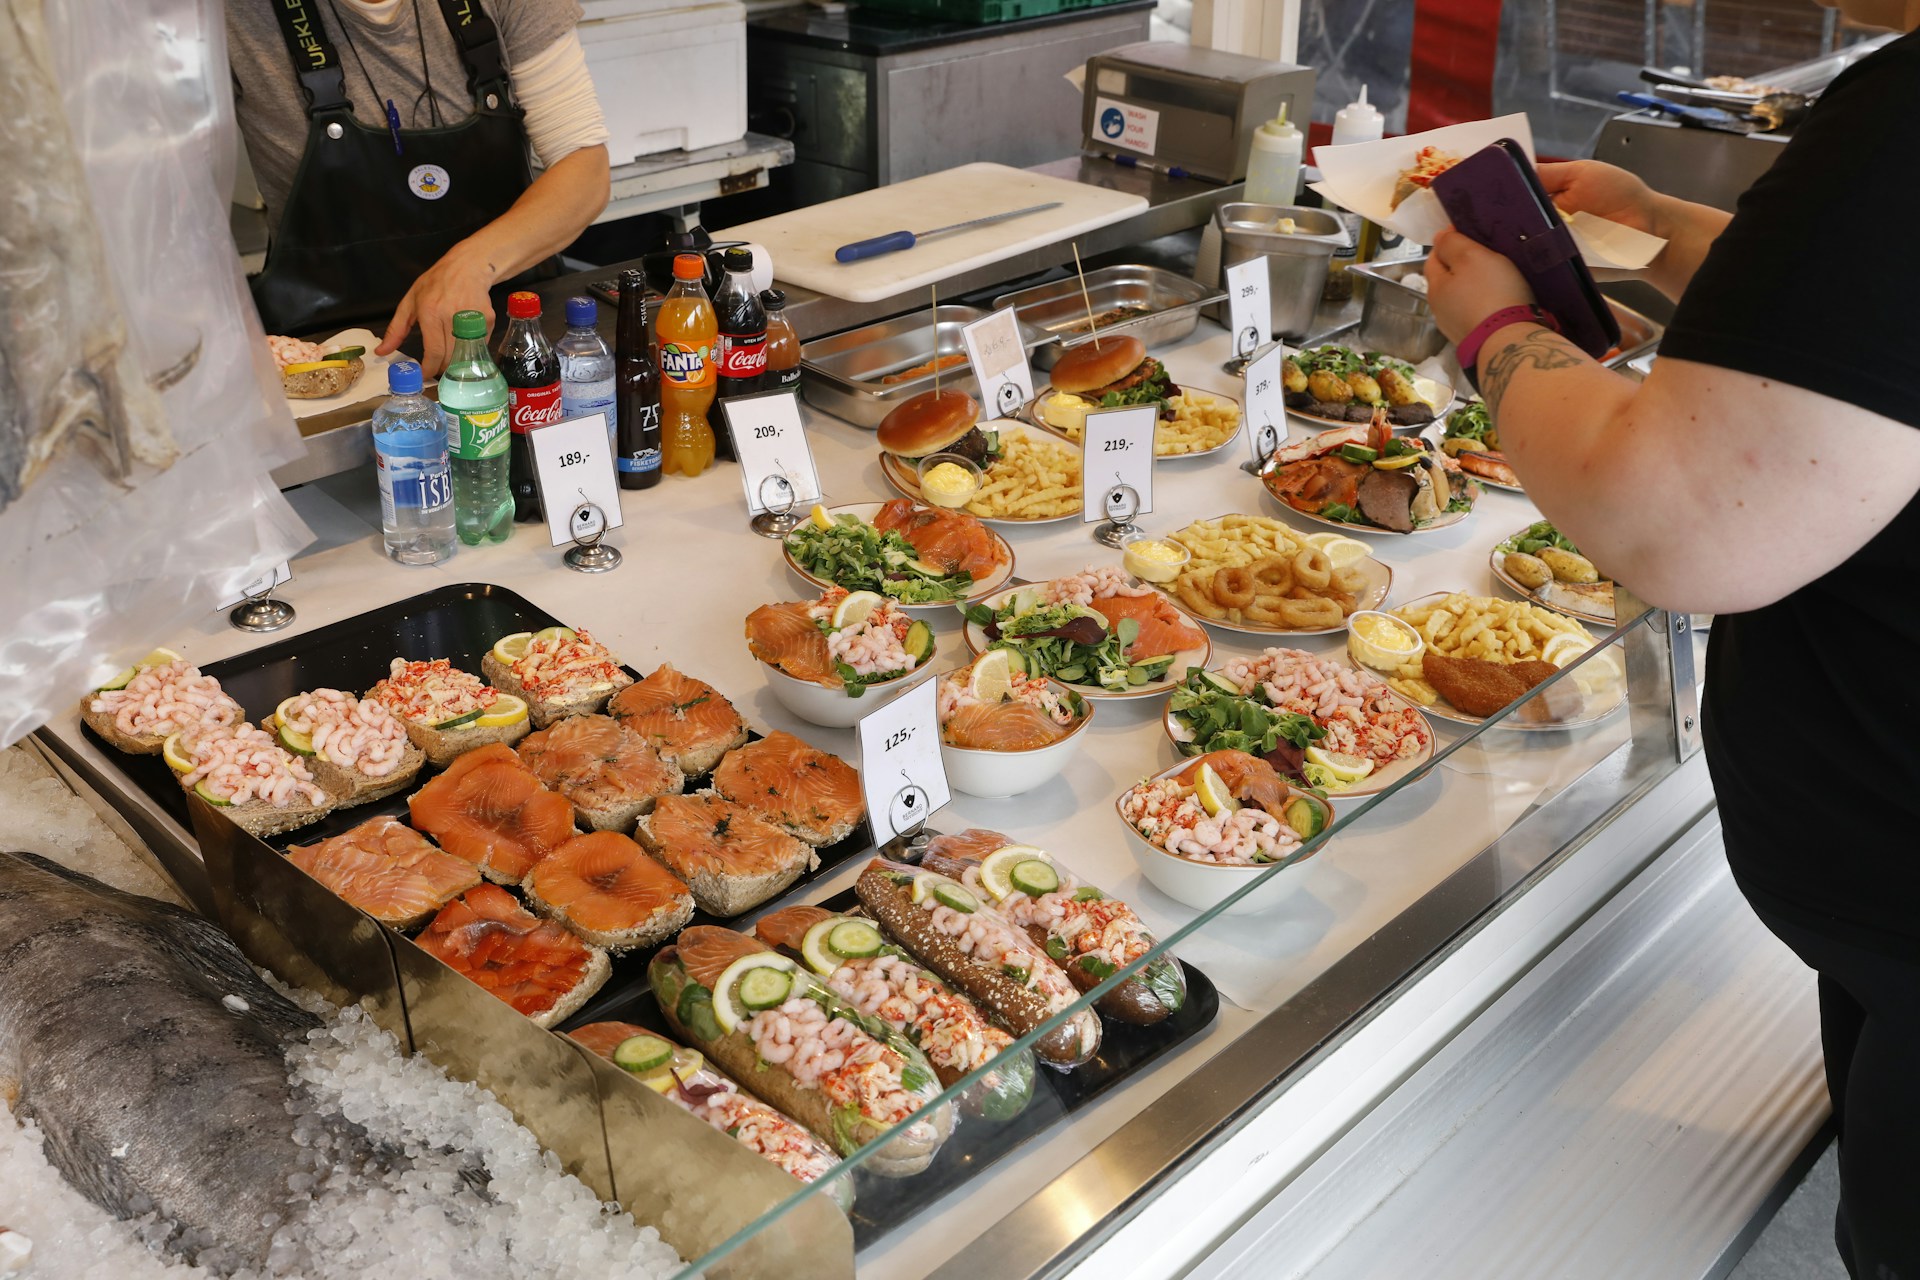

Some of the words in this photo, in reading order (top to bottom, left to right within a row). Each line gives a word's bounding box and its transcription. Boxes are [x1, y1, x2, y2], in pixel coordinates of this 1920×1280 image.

[1127, 110, 1147, 120] WASH
[1126, 122, 1144, 134] YOUR
[1241, 285, 1259, 298] 299,-
[660, 350, 704, 371] FANTA
[526, 390, 552, 398] ORIGINAL
[1255, 379, 1271, 396] 379,-
[477, 416, 508, 444] Sprite
[754, 425, 784, 439] 209,-
[1104, 438, 1134, 452] 219,-
[558, 451, 590, 468] 189,-
[885, 727, 917, 752] 125,-
